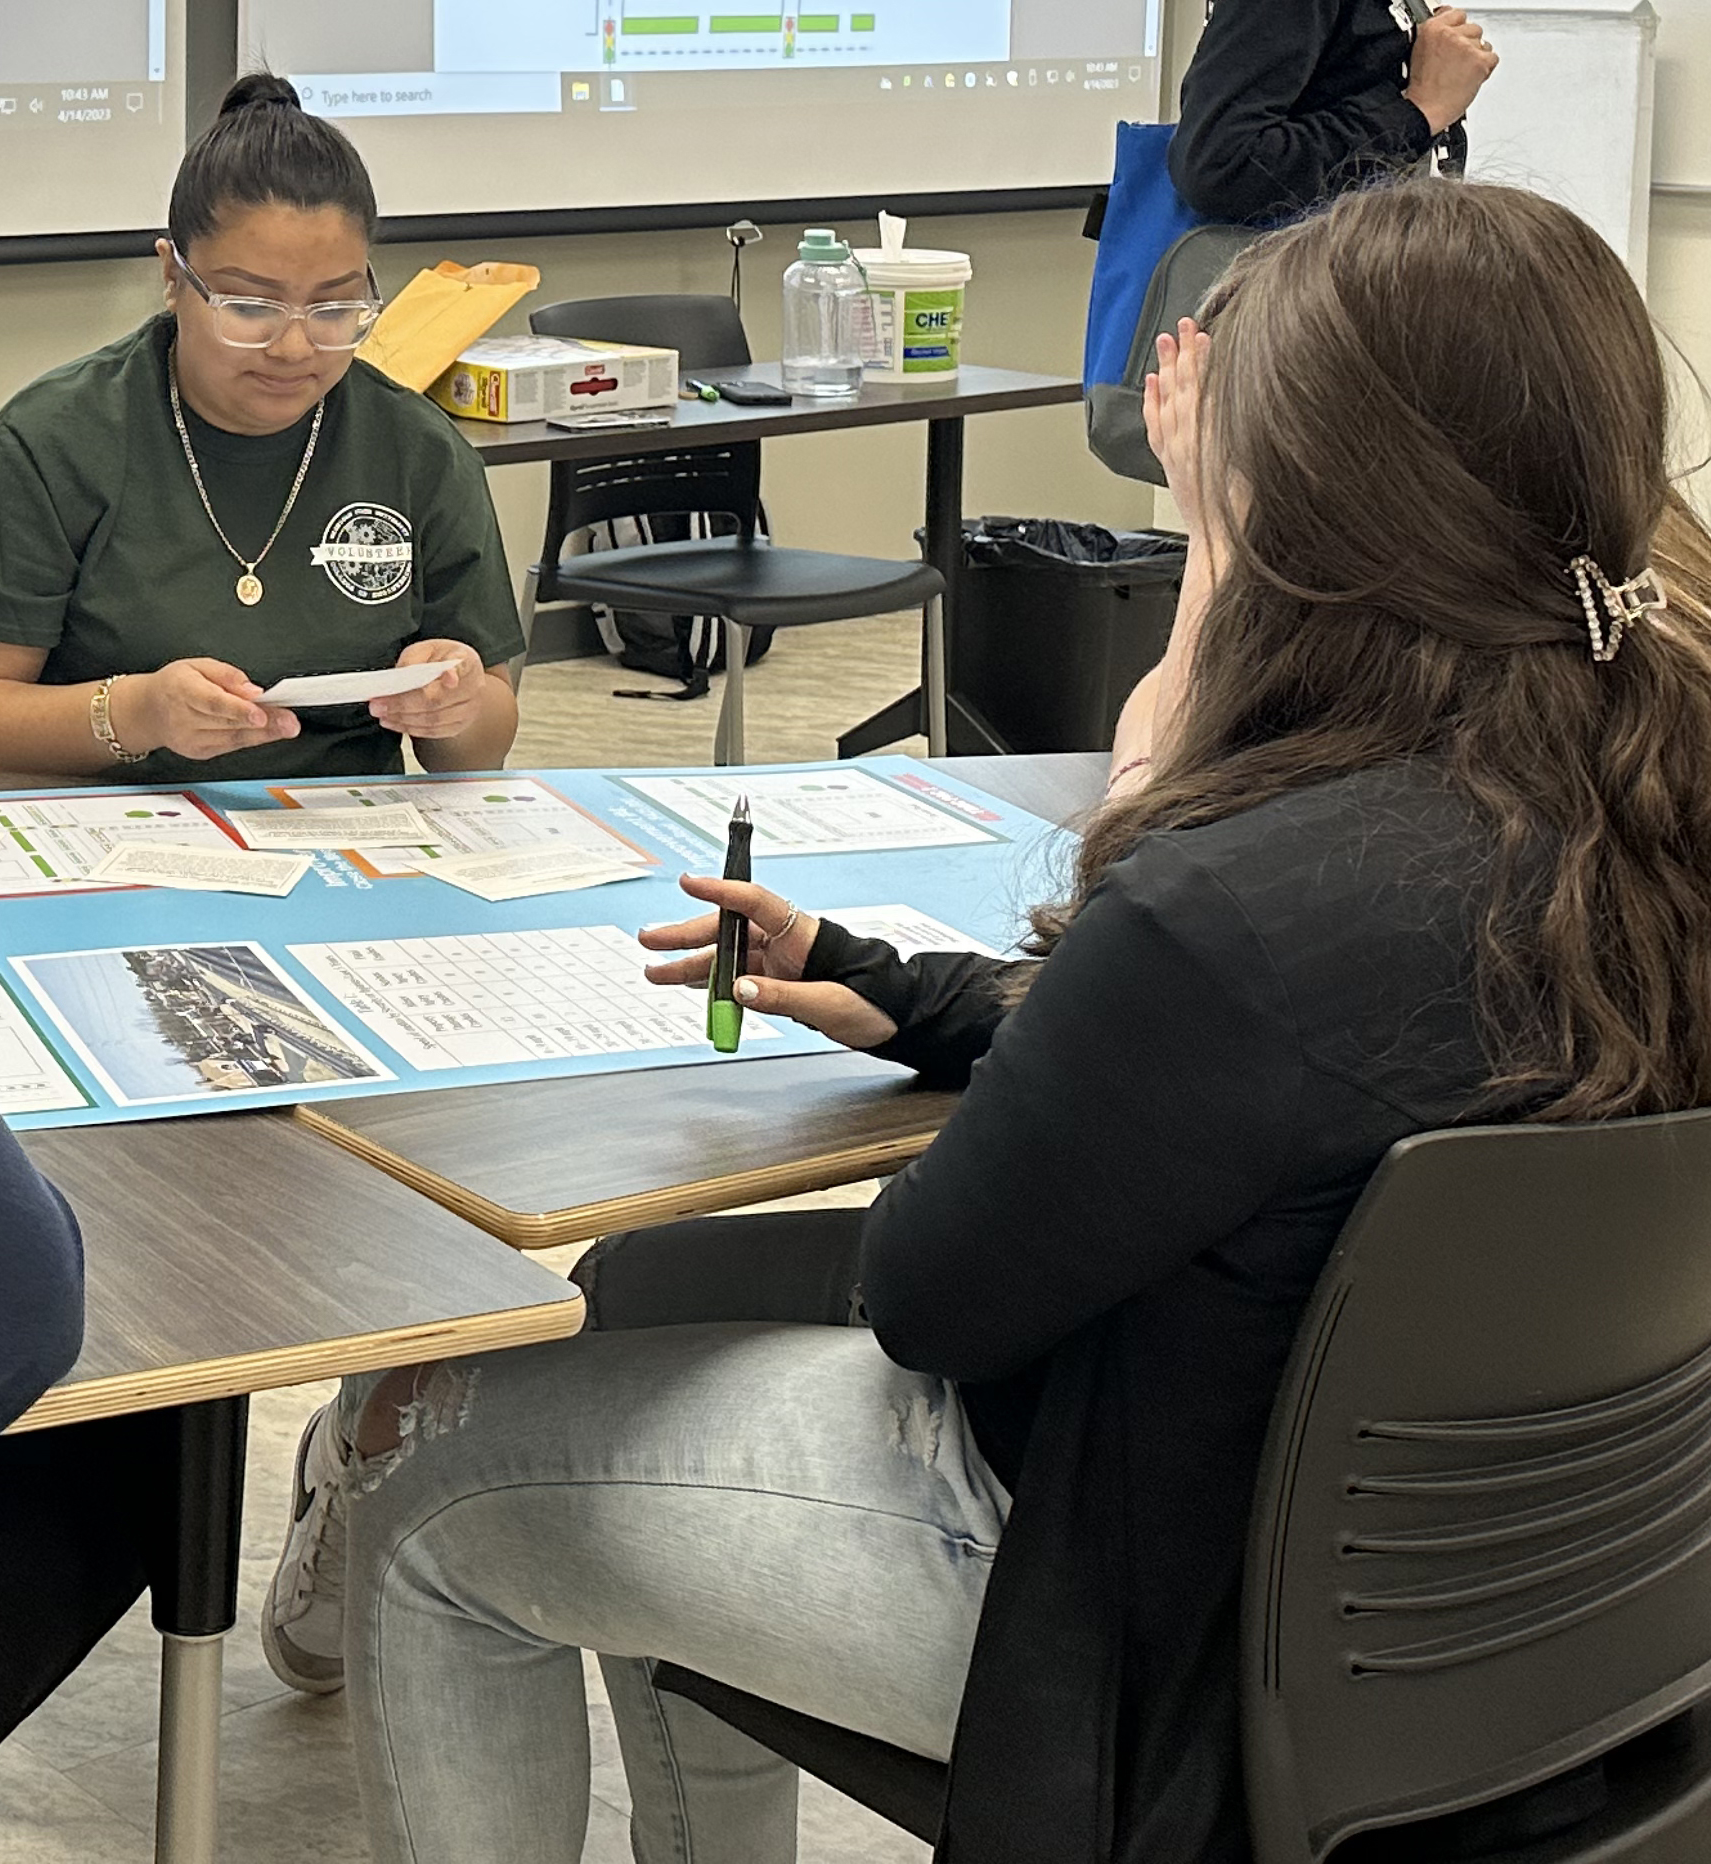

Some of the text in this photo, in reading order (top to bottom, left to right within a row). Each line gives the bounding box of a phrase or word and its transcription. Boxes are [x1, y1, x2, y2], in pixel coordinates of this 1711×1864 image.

[61, 87, 109, 101] 10:43 AM
[321, 88, 433, 107] Type here to search
